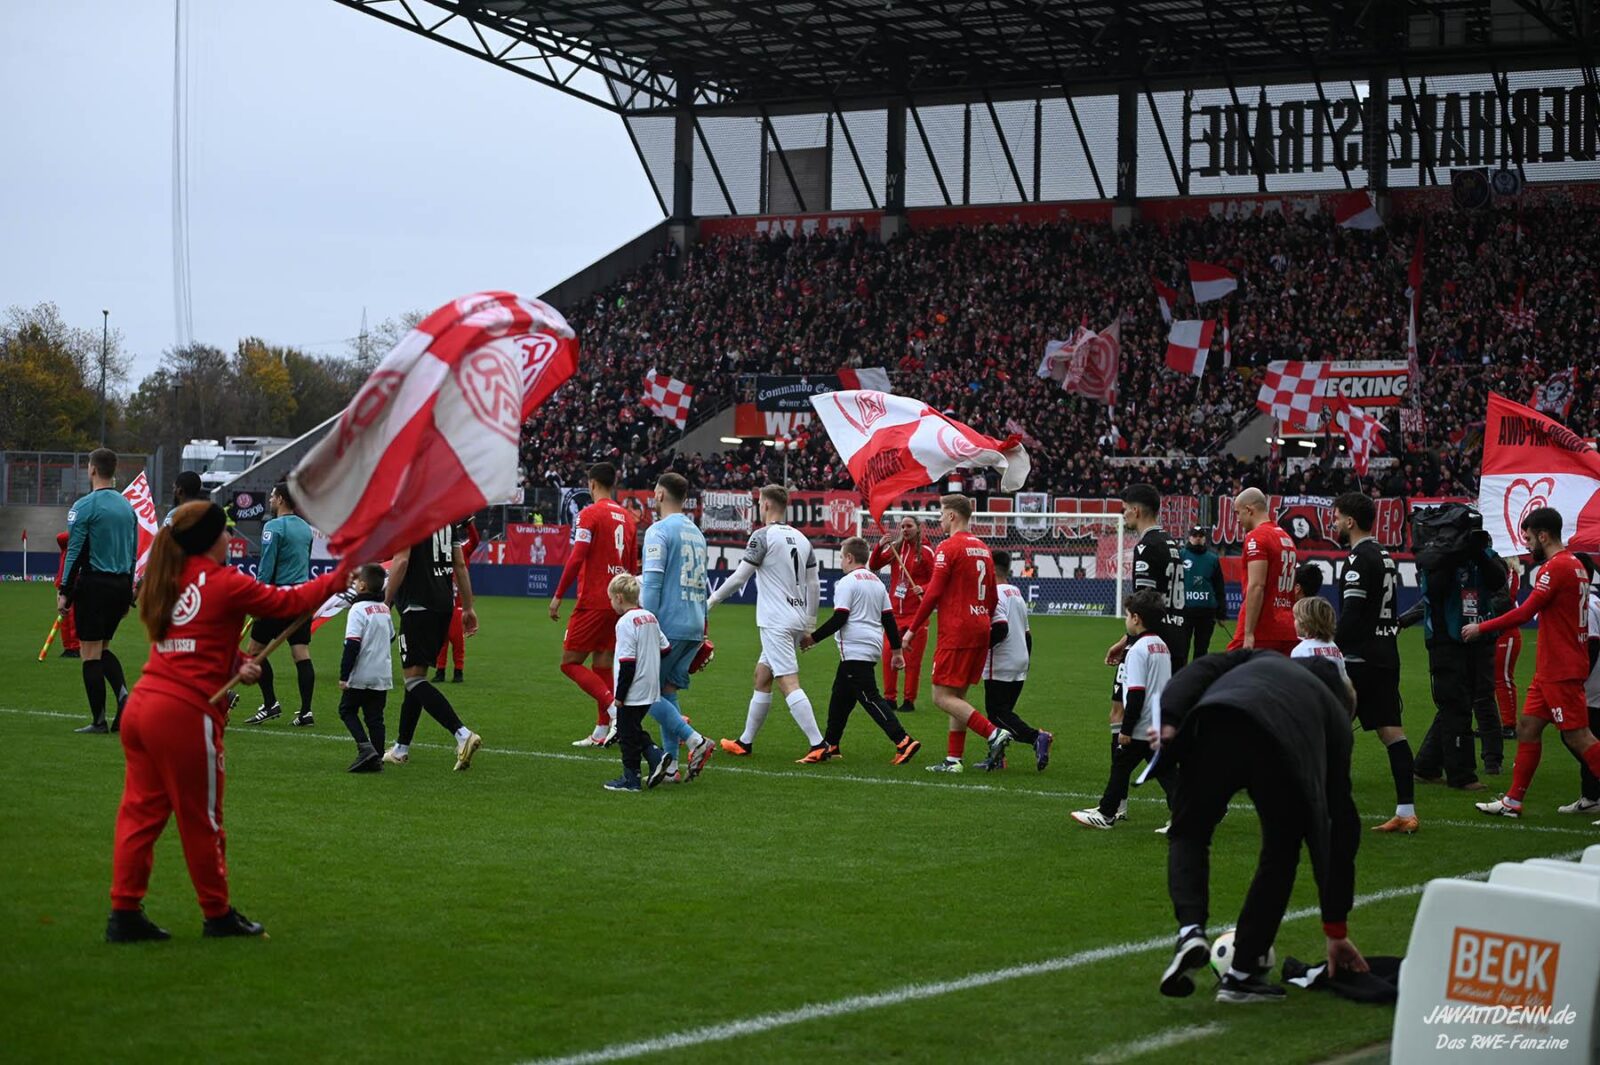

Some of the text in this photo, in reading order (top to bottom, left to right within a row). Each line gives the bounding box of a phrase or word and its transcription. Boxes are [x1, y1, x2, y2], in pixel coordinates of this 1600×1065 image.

[758, 383, 813, 401] Commando
[1326, 376, 1408, 397] ECKING
[614, 524, 625, 561] 4
[790, 547, 799, 585] 1
[976, 559, 986, 601] 2
[1277, 550, 1297, 593] 33
[1161, 562, 1185, 610] 36
[1186, 591, 1209, 600] HOST
[1048, 602, 1105, 611] GARTENBAU
[1551, 707, 1563, 722] 23
[1455, 933, 1552, 992] BECK
